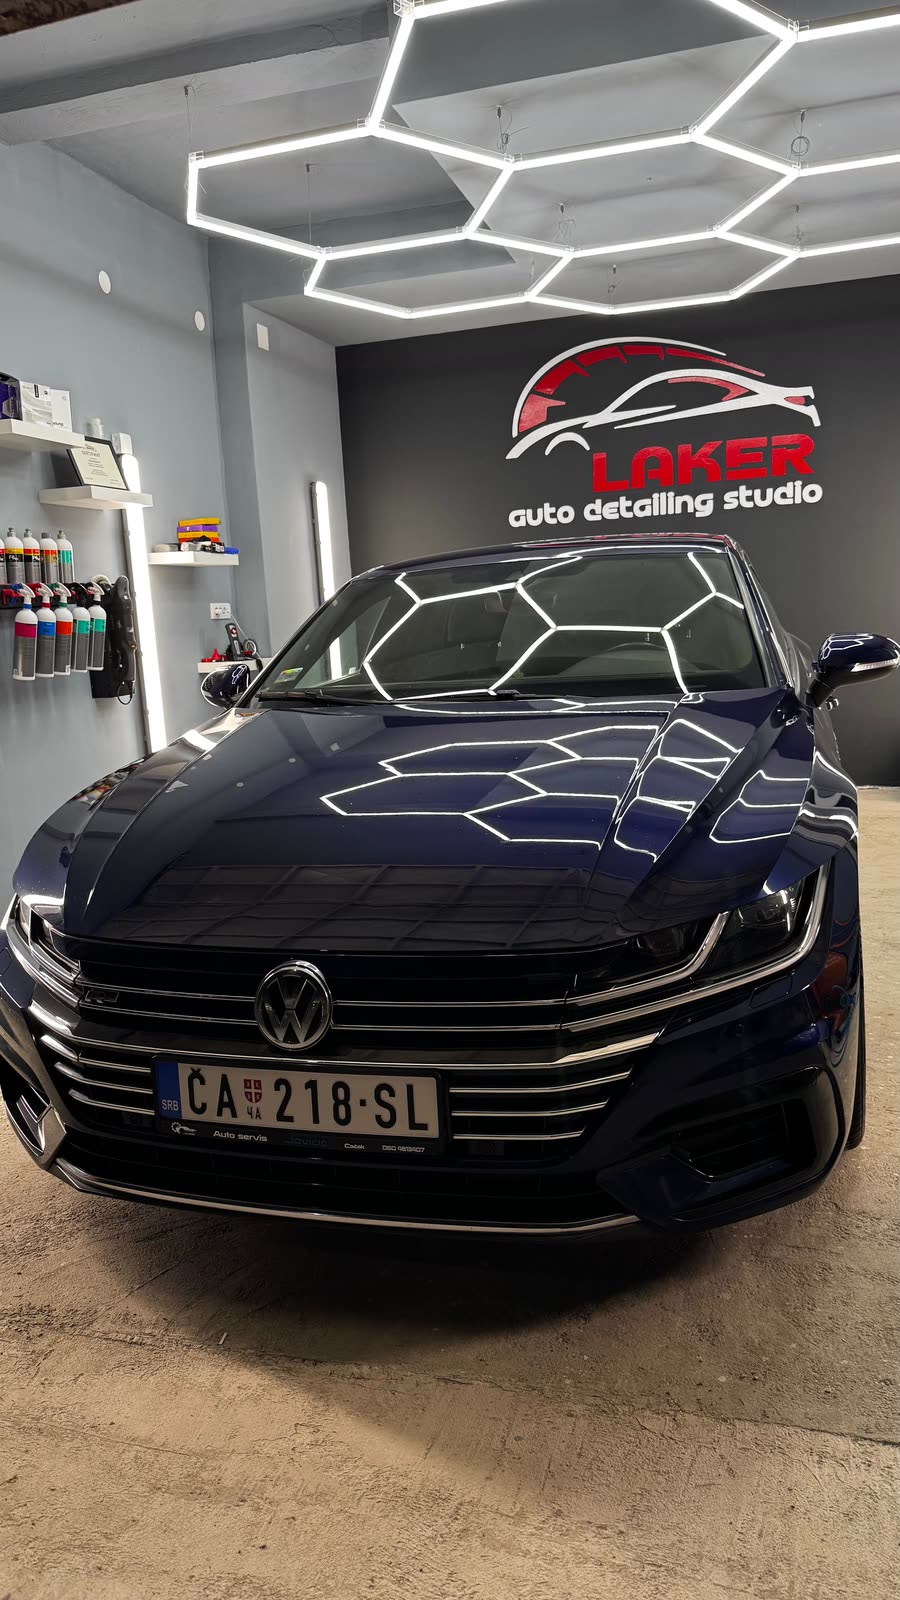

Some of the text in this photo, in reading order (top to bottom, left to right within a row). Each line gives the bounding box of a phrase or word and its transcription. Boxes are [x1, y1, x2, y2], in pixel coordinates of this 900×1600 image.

[592, 433, 815, 492] LAKER
[508, 480, 823, 528] auto detailing studio
[161, 1098, 180, 1112] SRB
[187, 1067, 238, 1121] ČA
[212, 1130, 236, 1139] Auto
[237, 1133, 268, 1142] servis
